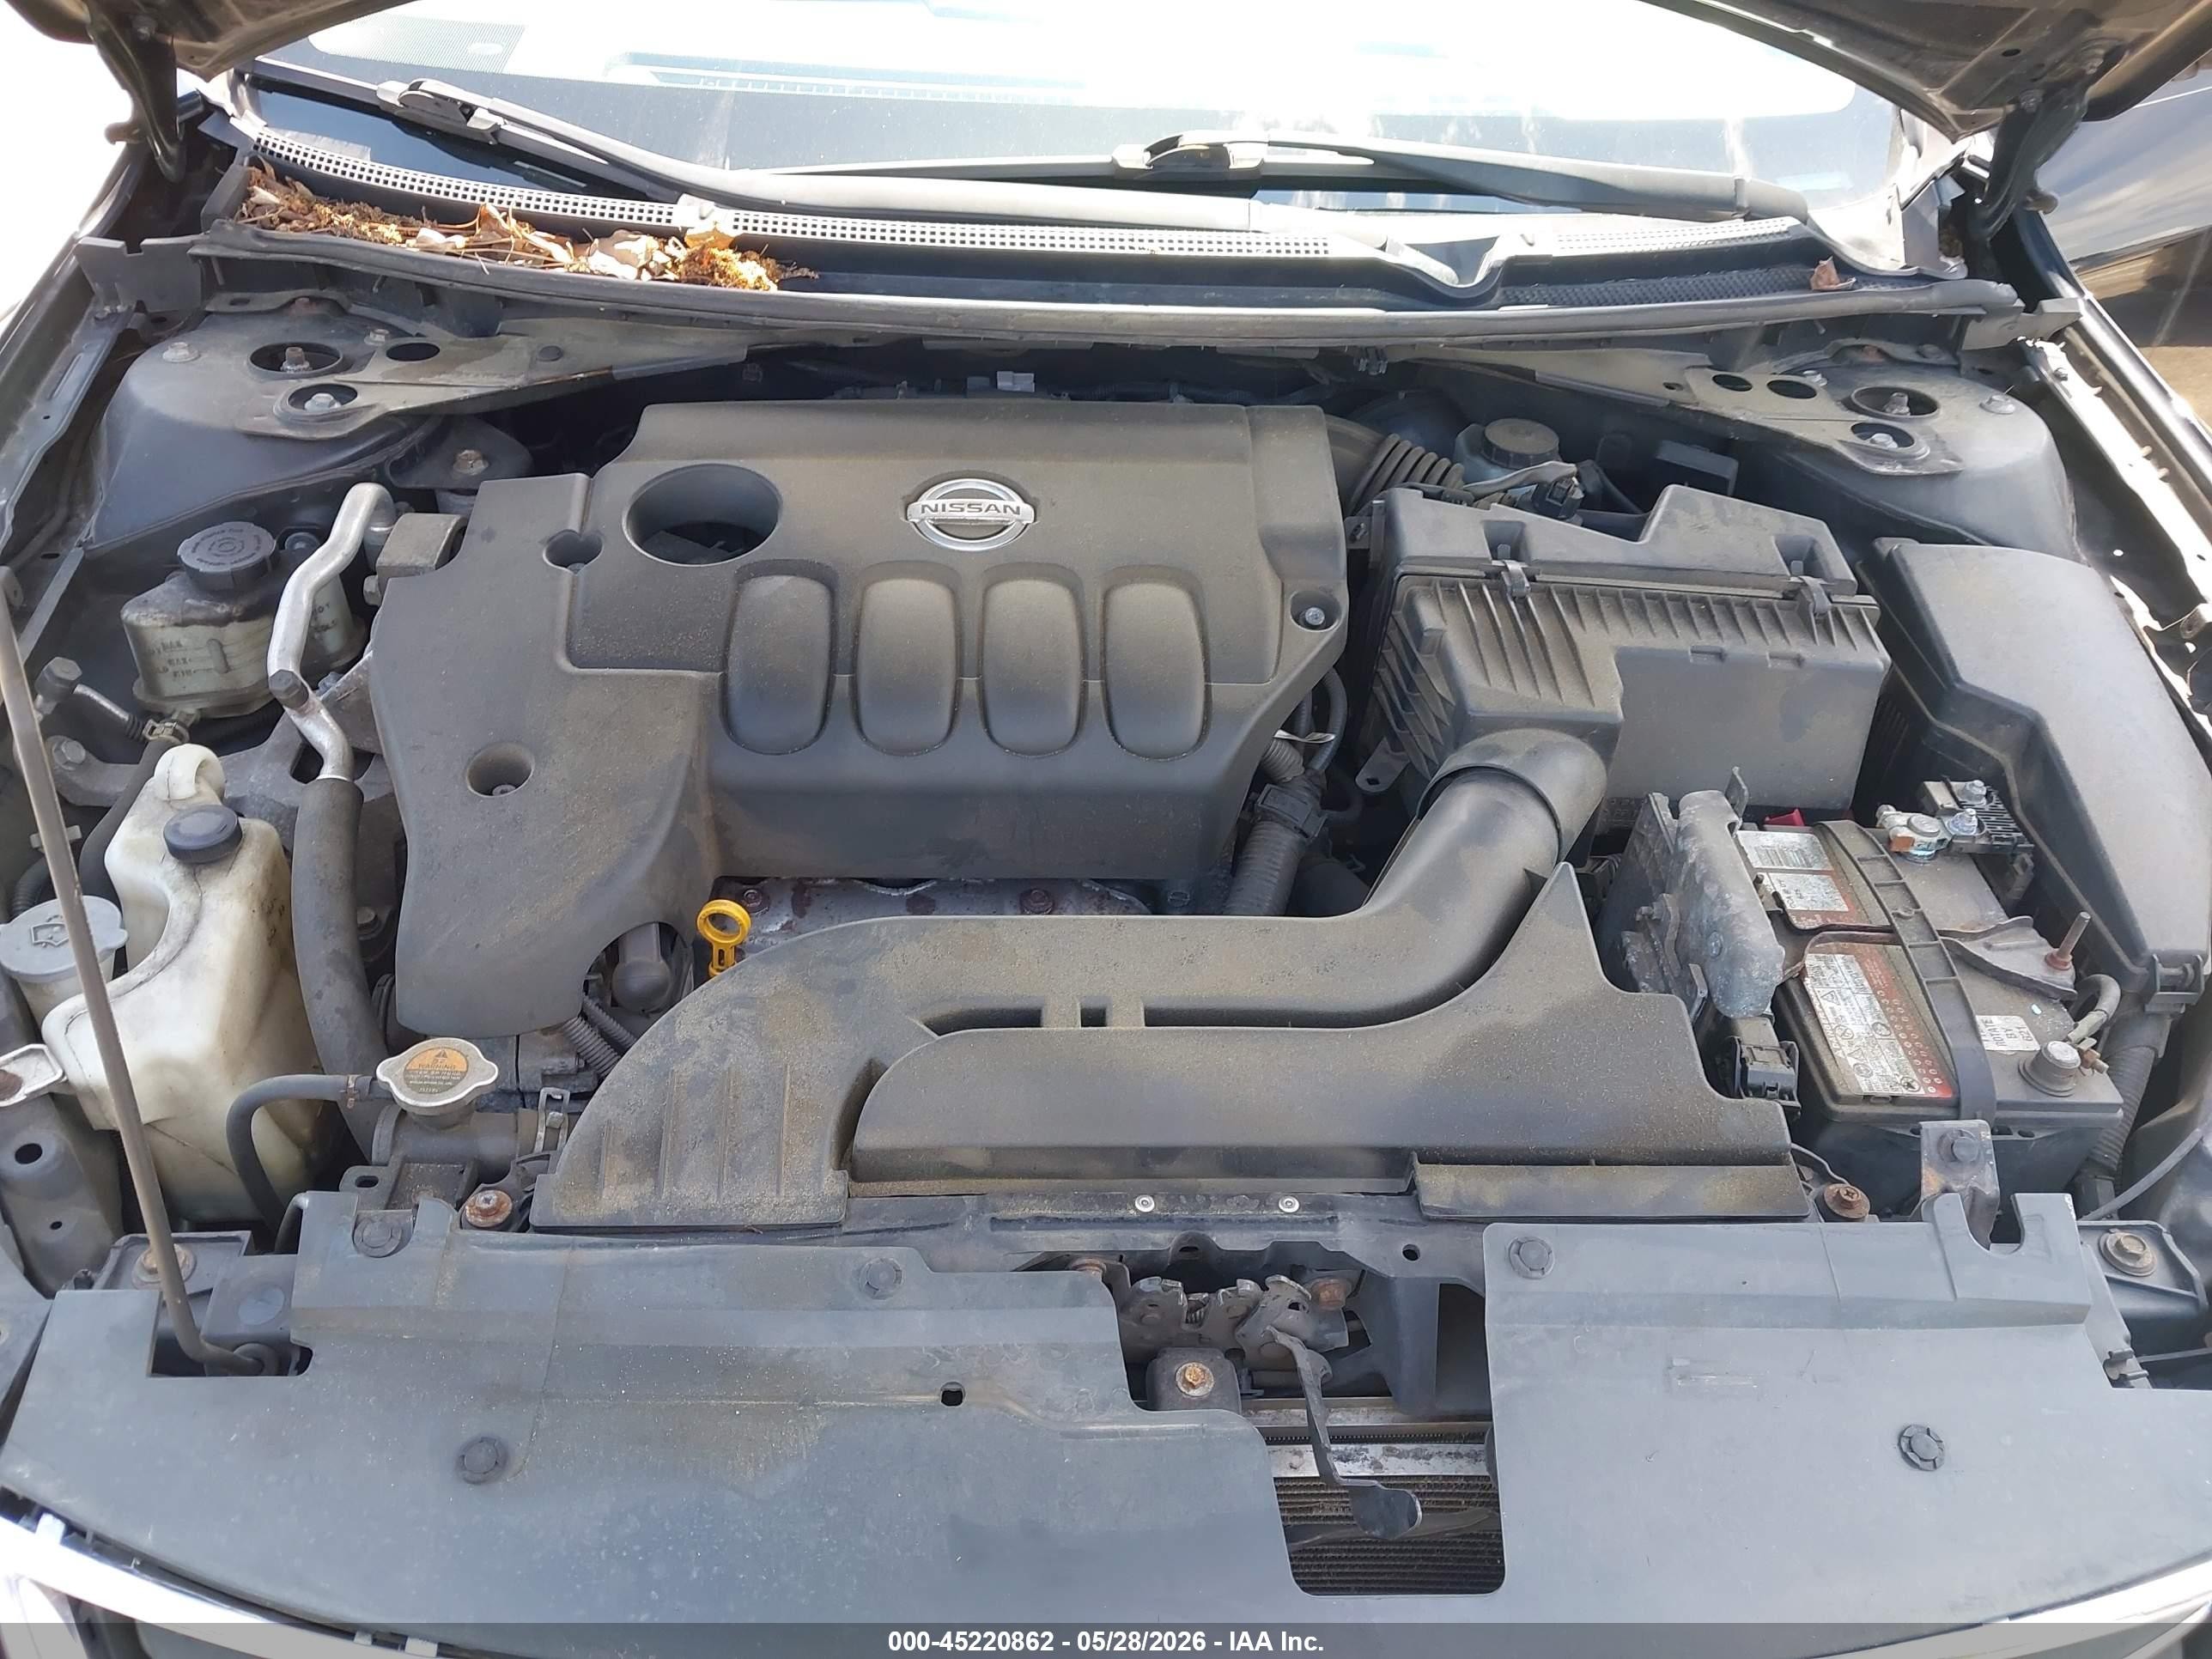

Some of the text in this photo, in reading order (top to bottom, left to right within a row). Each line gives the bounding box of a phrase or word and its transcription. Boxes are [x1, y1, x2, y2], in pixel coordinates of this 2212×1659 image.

[921, 502, 1021, 515] NISSAN
[1984, 1018, 2008, 1047] ROTATE
[2002, 1027, 2018, 1039] BY
